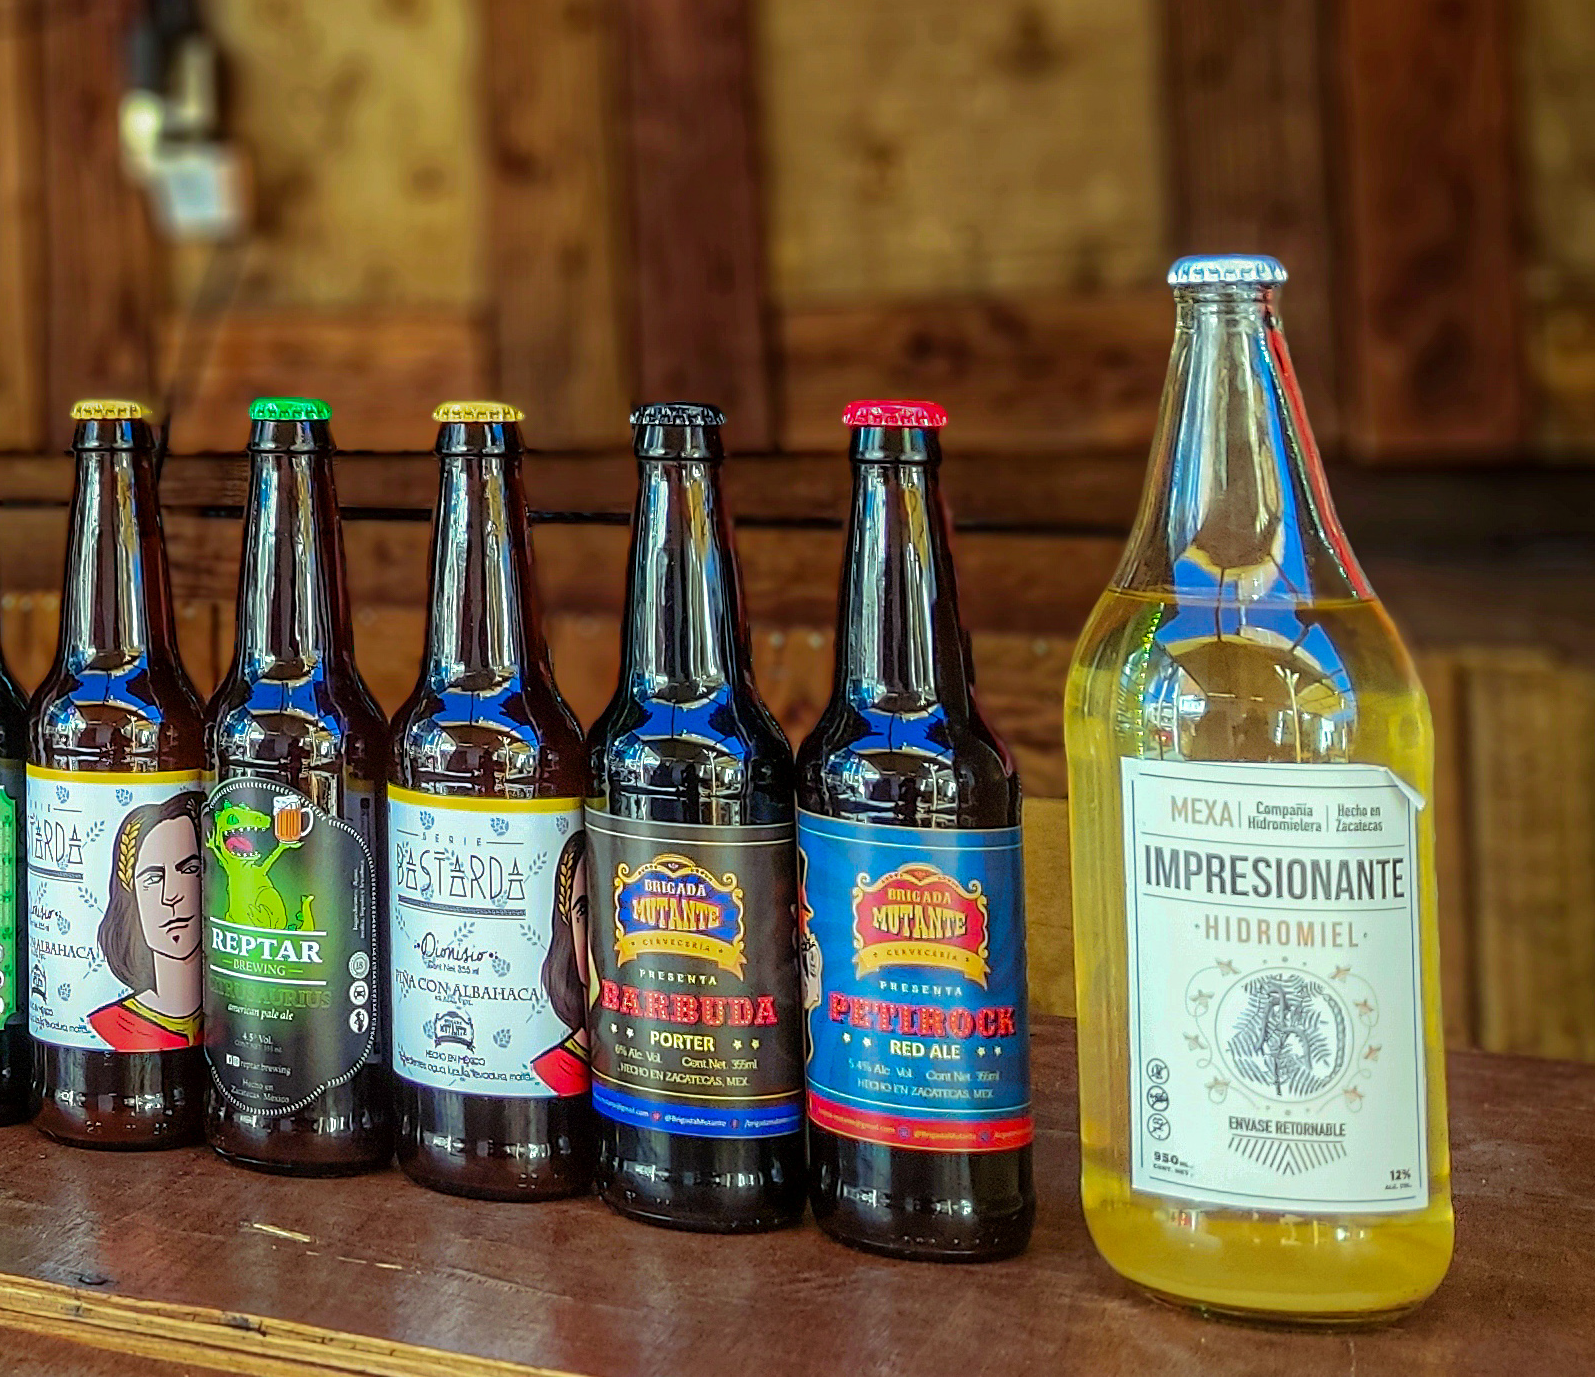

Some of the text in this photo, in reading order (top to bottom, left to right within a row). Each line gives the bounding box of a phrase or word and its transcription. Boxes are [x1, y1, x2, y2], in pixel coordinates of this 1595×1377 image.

[1170, 795, 1235, 828] MEXA
[1337, 803, 1368, 818] Hecho
[1335, 818, 1384, 832] Zacatecas
[396, 842, 525, 901] BASTARDA
[1143, 844, 1406, 901] IMPRESIONANTE
[643, 879, 706, 897] BRIGADA
[887, 887, 952, 904] BRIGADA
[632, 897, 721, 931] MUTANTE
[871, 904, 968, 940] MUTANTE
[1204, 913, 1360, 949] HIDROMIEL
[211, 926, 323, 963] REPTAR
[420, 931, 489, 963] Dionisio
[233, 958, 286, 976] BREWING
[638, 968, 717, 986] PRESENTA
[417, 977, 449, 995] CON
[453, 983, 541, 1003] ALBAHACA
[878, 980, 963, 997] PRESENTA
[601, 977, 779, 1027] BARBUDA
[260, 1008, 279, 1021] pale
[279, 1009, 294, 1021] ale
[828, 991, 1018, 1040] PETIROCK
[649, 1030, 716, 1053] PORTER
[889, 1039, 961, 1059] RED ALE
[649, 1067, 664, 1081] EN
[665, 1071, 725, 1087] ZACATECAS,
[893, 1083, 909, 1095] EN
[1228, 1115, 1347, 1137] ENVASE RETORNABLE
[1389, 1168, 1412, 1182] 12%
